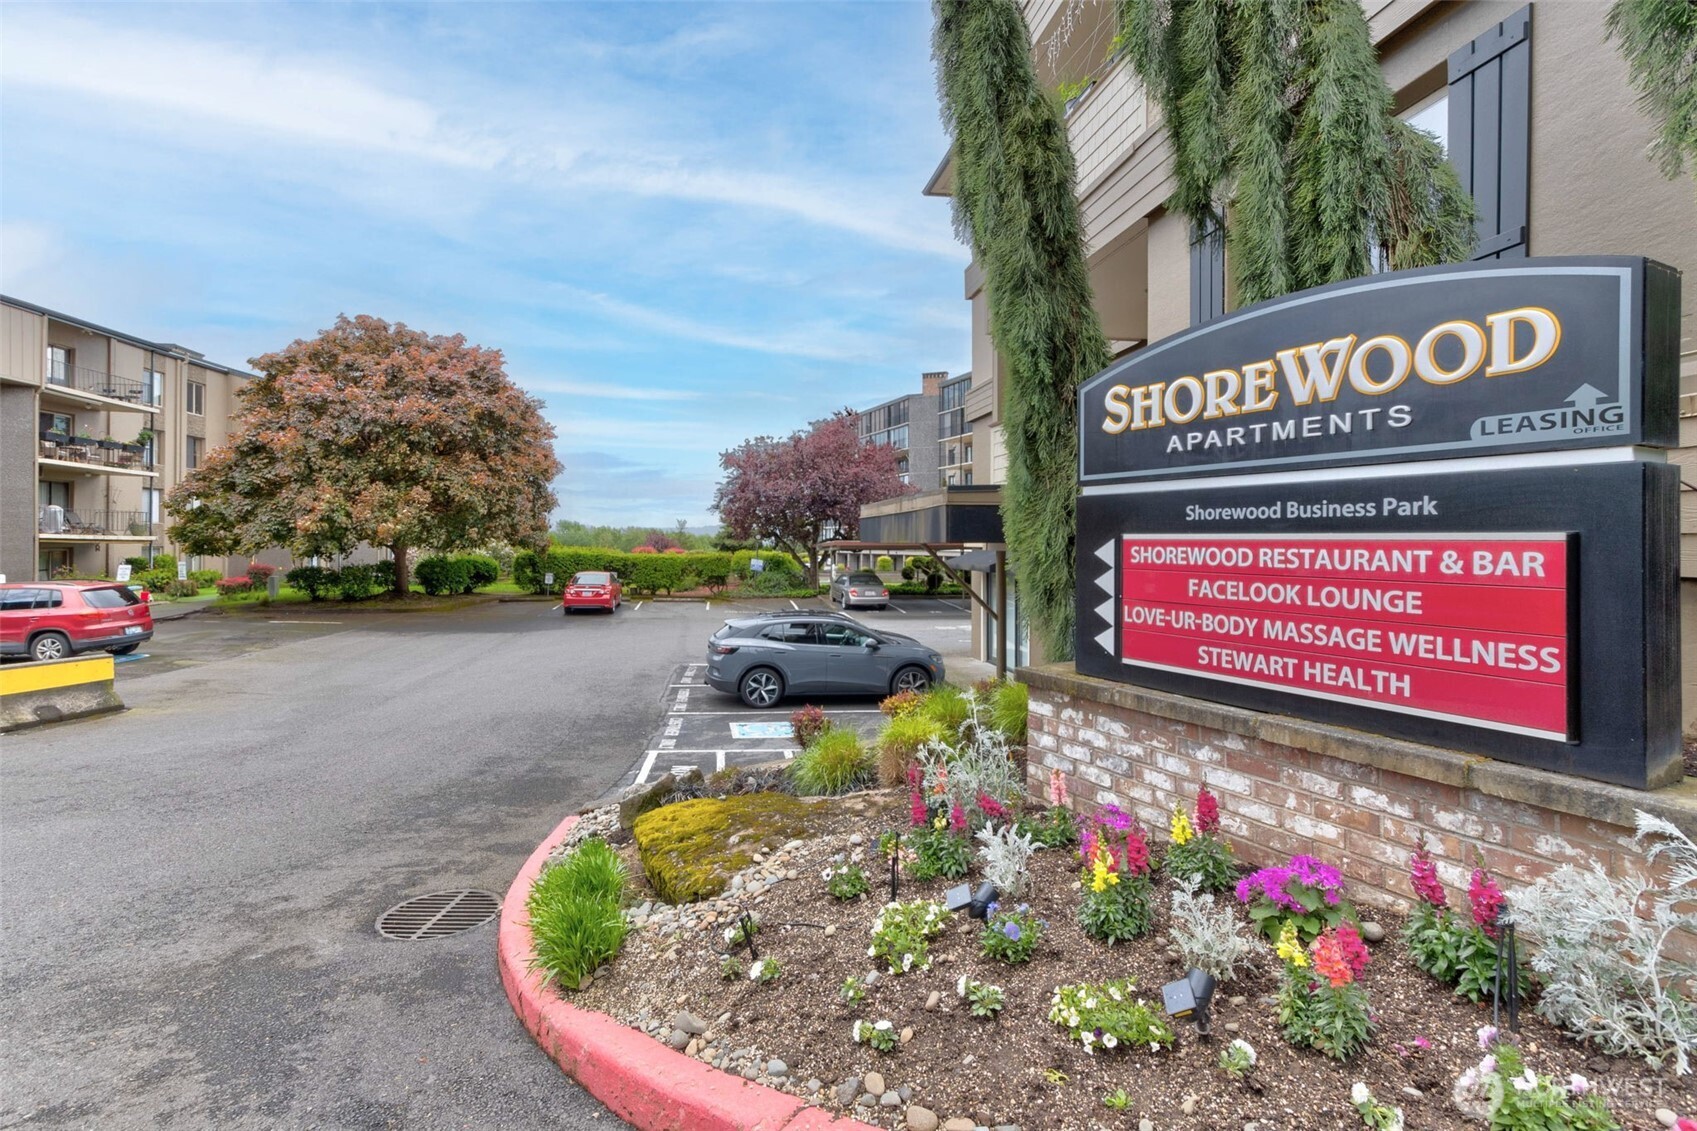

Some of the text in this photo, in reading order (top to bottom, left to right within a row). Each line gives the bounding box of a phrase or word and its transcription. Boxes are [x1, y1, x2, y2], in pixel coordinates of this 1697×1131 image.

[1102, 306, 1562, 434] SHOREWOOD
[1166, 404, 1413, 453] APARTMENTS
[1480, 405, 1624, 436] LEASING
[1573, 423, 1624, 435] OFFICE
[1185, 494, 1439, 521] Shorewood Business Park
[1130, 545, 1546, 578] SHOREWOOD RESTAURANT & BAR
[1188, 578, 1423, 615] FACELOOK LOUNGE
[1124, 605, 1561, 674] LOVE-UR-BODY MASSAGE WELLNESS
[1198, 645, 1411, 698] STEWART HEALTH
